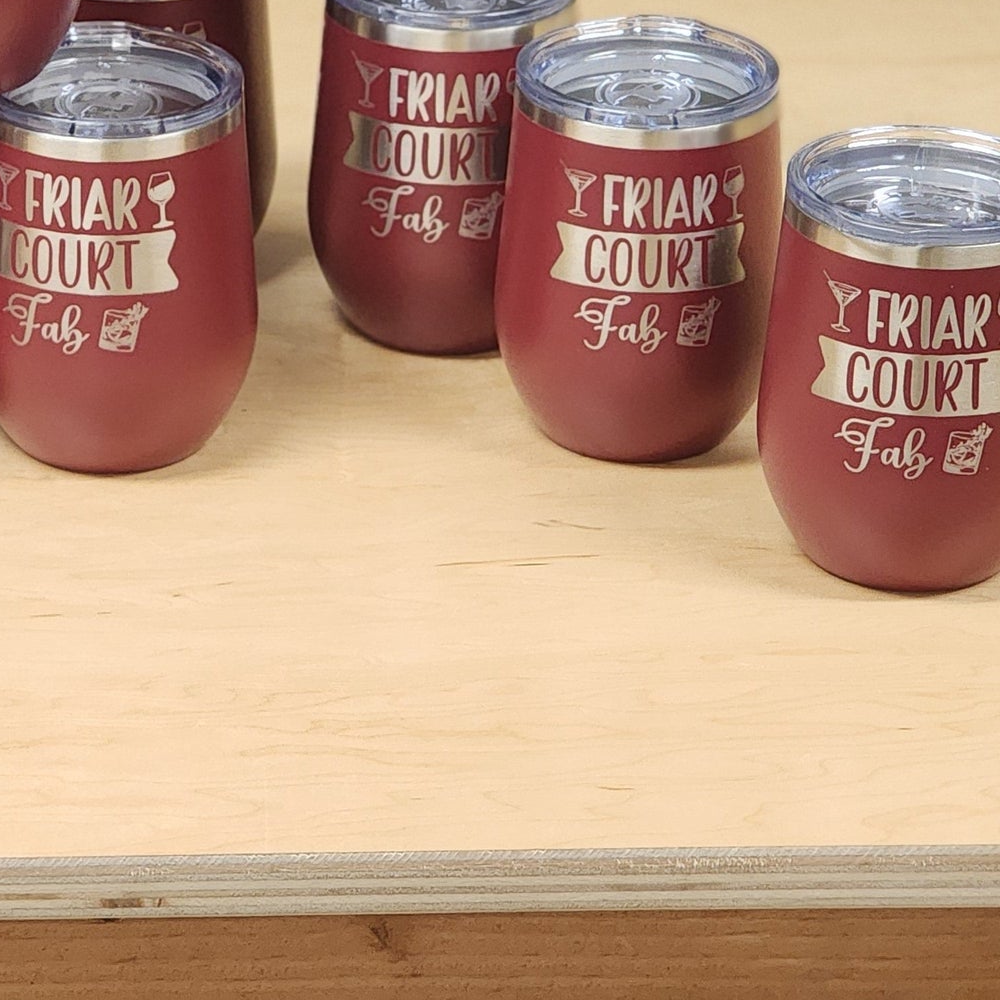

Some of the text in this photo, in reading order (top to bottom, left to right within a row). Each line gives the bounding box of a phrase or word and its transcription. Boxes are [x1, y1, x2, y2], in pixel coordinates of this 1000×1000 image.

[389, 67, 500, 124] FRIAR
[372, 125, 499, 181] COURT
[25, 168, 141, 231] FRIAR
[362, 185, 450, 243] Fab
[603, 173, 718, 229] FRIAR
[10, 229, 141, 290] COURT
[584, 234, 716, 289] COURT
[3, 292, 90, 355] Fab
[574, 294, 668, 354] Fab
[867, 288, 992, 350] FRIAR
[846, 351, 989, 412] COURT
[833, 417, 934, 480] Fab
